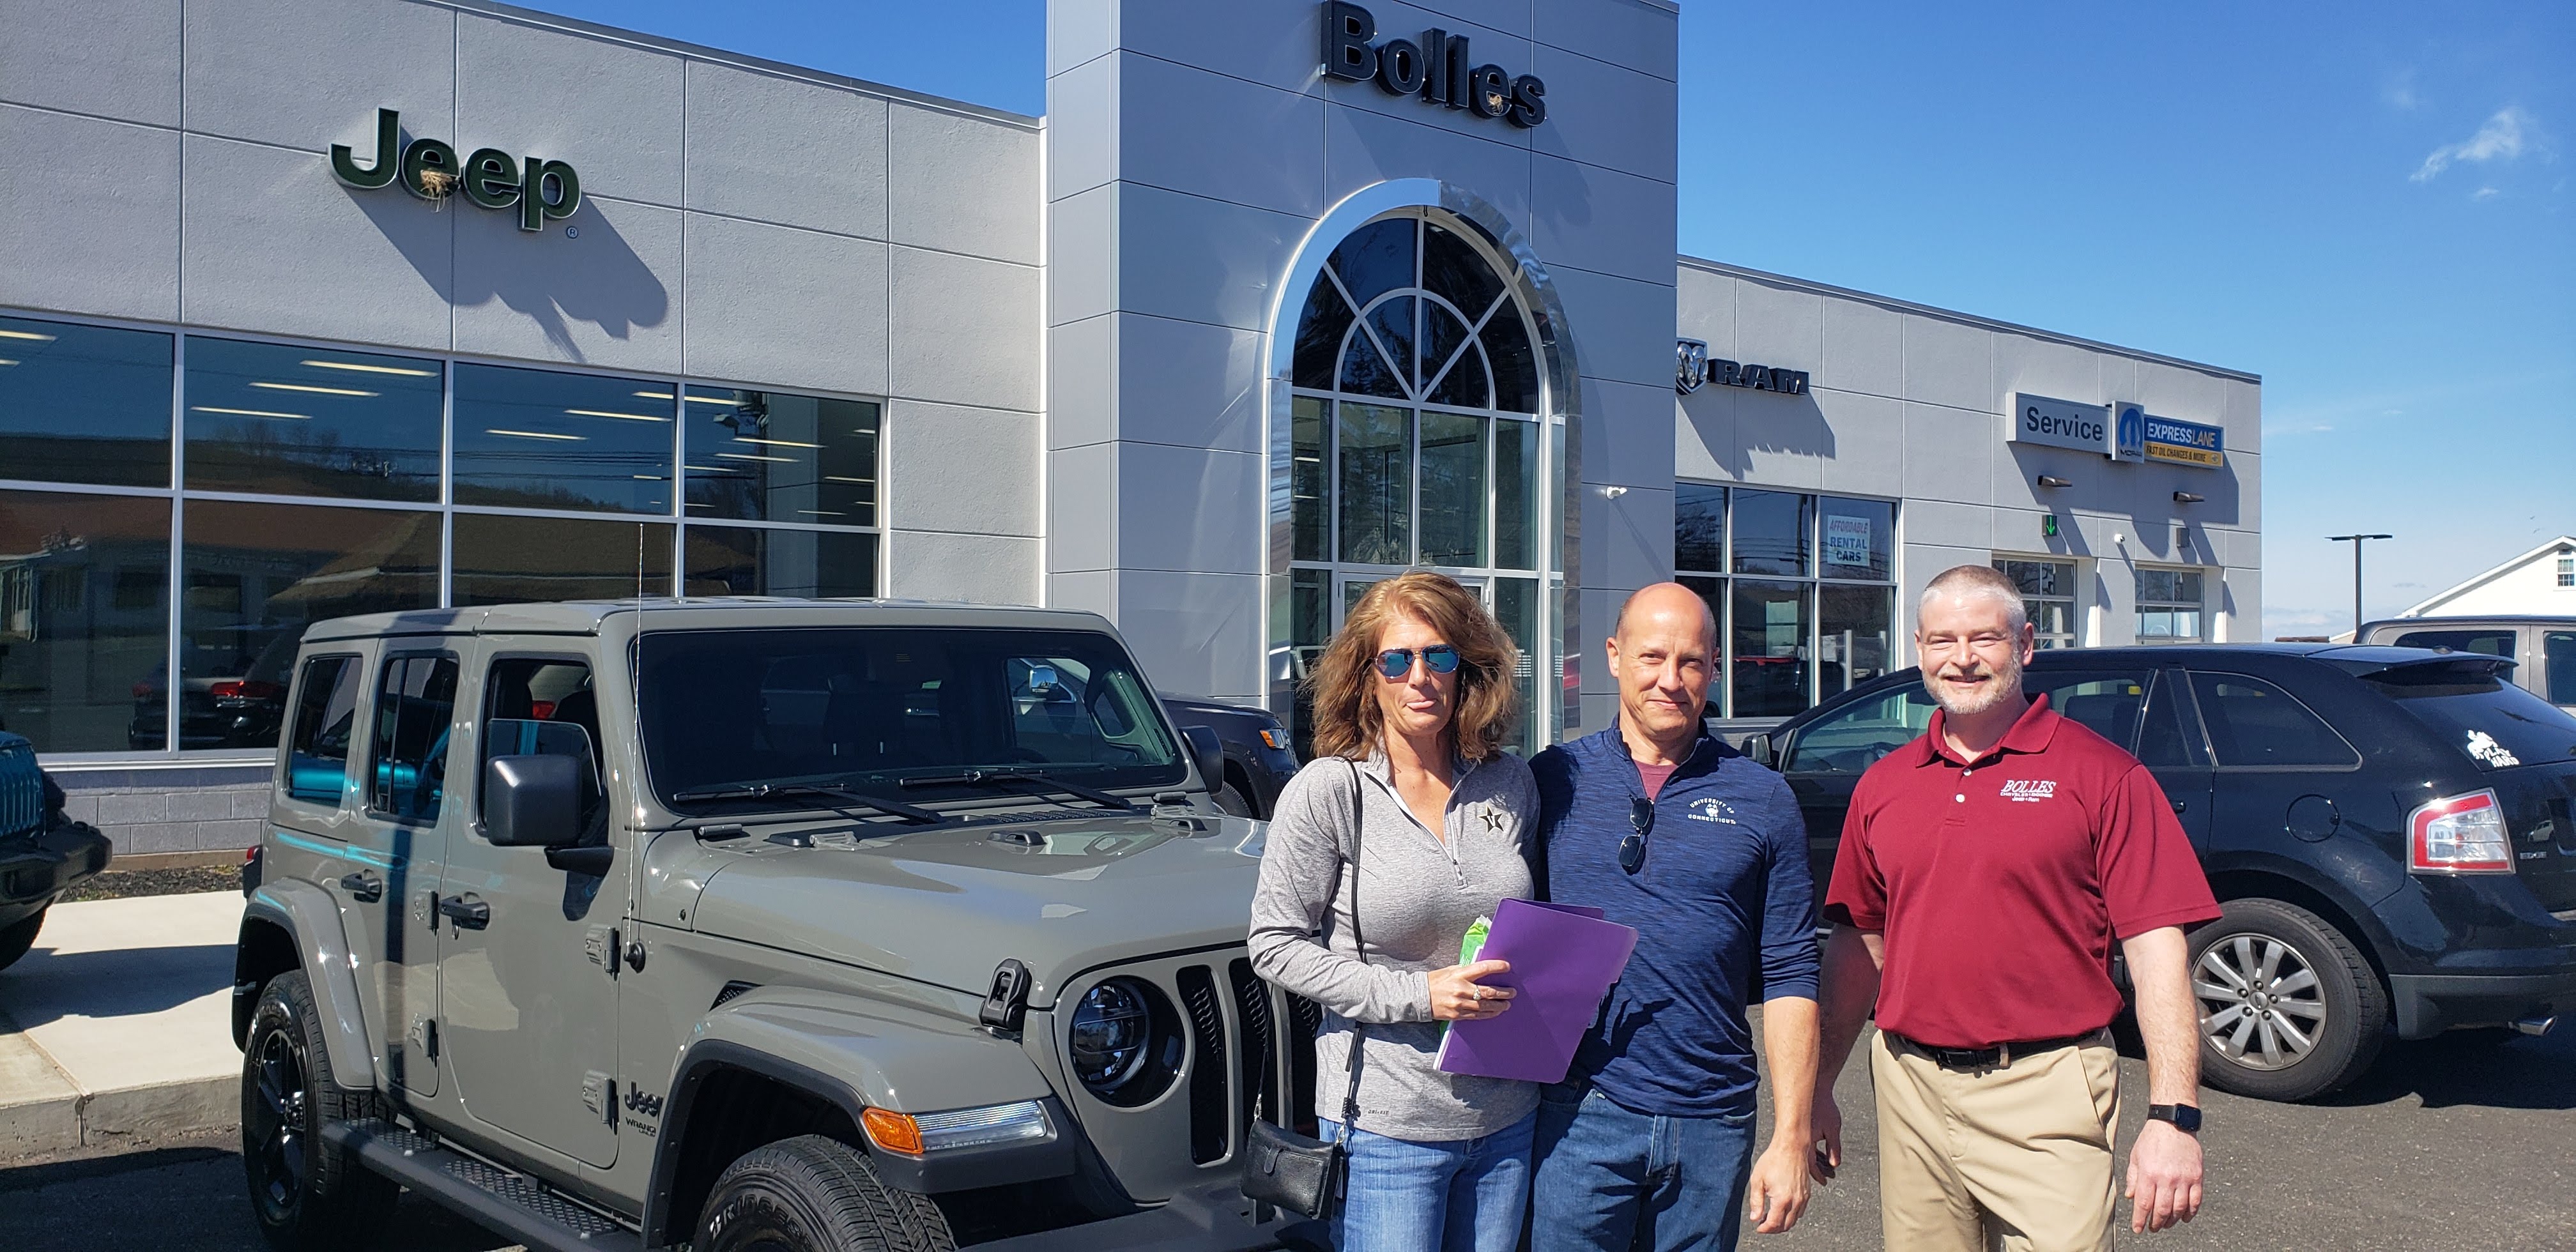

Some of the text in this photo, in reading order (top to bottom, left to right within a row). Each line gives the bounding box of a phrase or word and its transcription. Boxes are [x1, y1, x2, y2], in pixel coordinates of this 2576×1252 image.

[1321, 1, 1547, 128] Bolles
[329, 107, 582, 231] Jeep
[1706, 358, 1809, 395] RAM
[2027, 406, 2103, 441] Service
[1830, 520, 1868, 534] AFFORDABLE
[1830, 537, 1867, 549] RENTAL
[1836, 551, 1861, 561] CARS
[2483, 747, 2511, 761] PLAY
[2490, 755, 2519, 768] HARD
[2000, 779, 2057, 793] BOLLES
[1689, 798, 1726, 808] UNIVERSITY
[1687, 814, 1735, 825] CONNECTICUT
